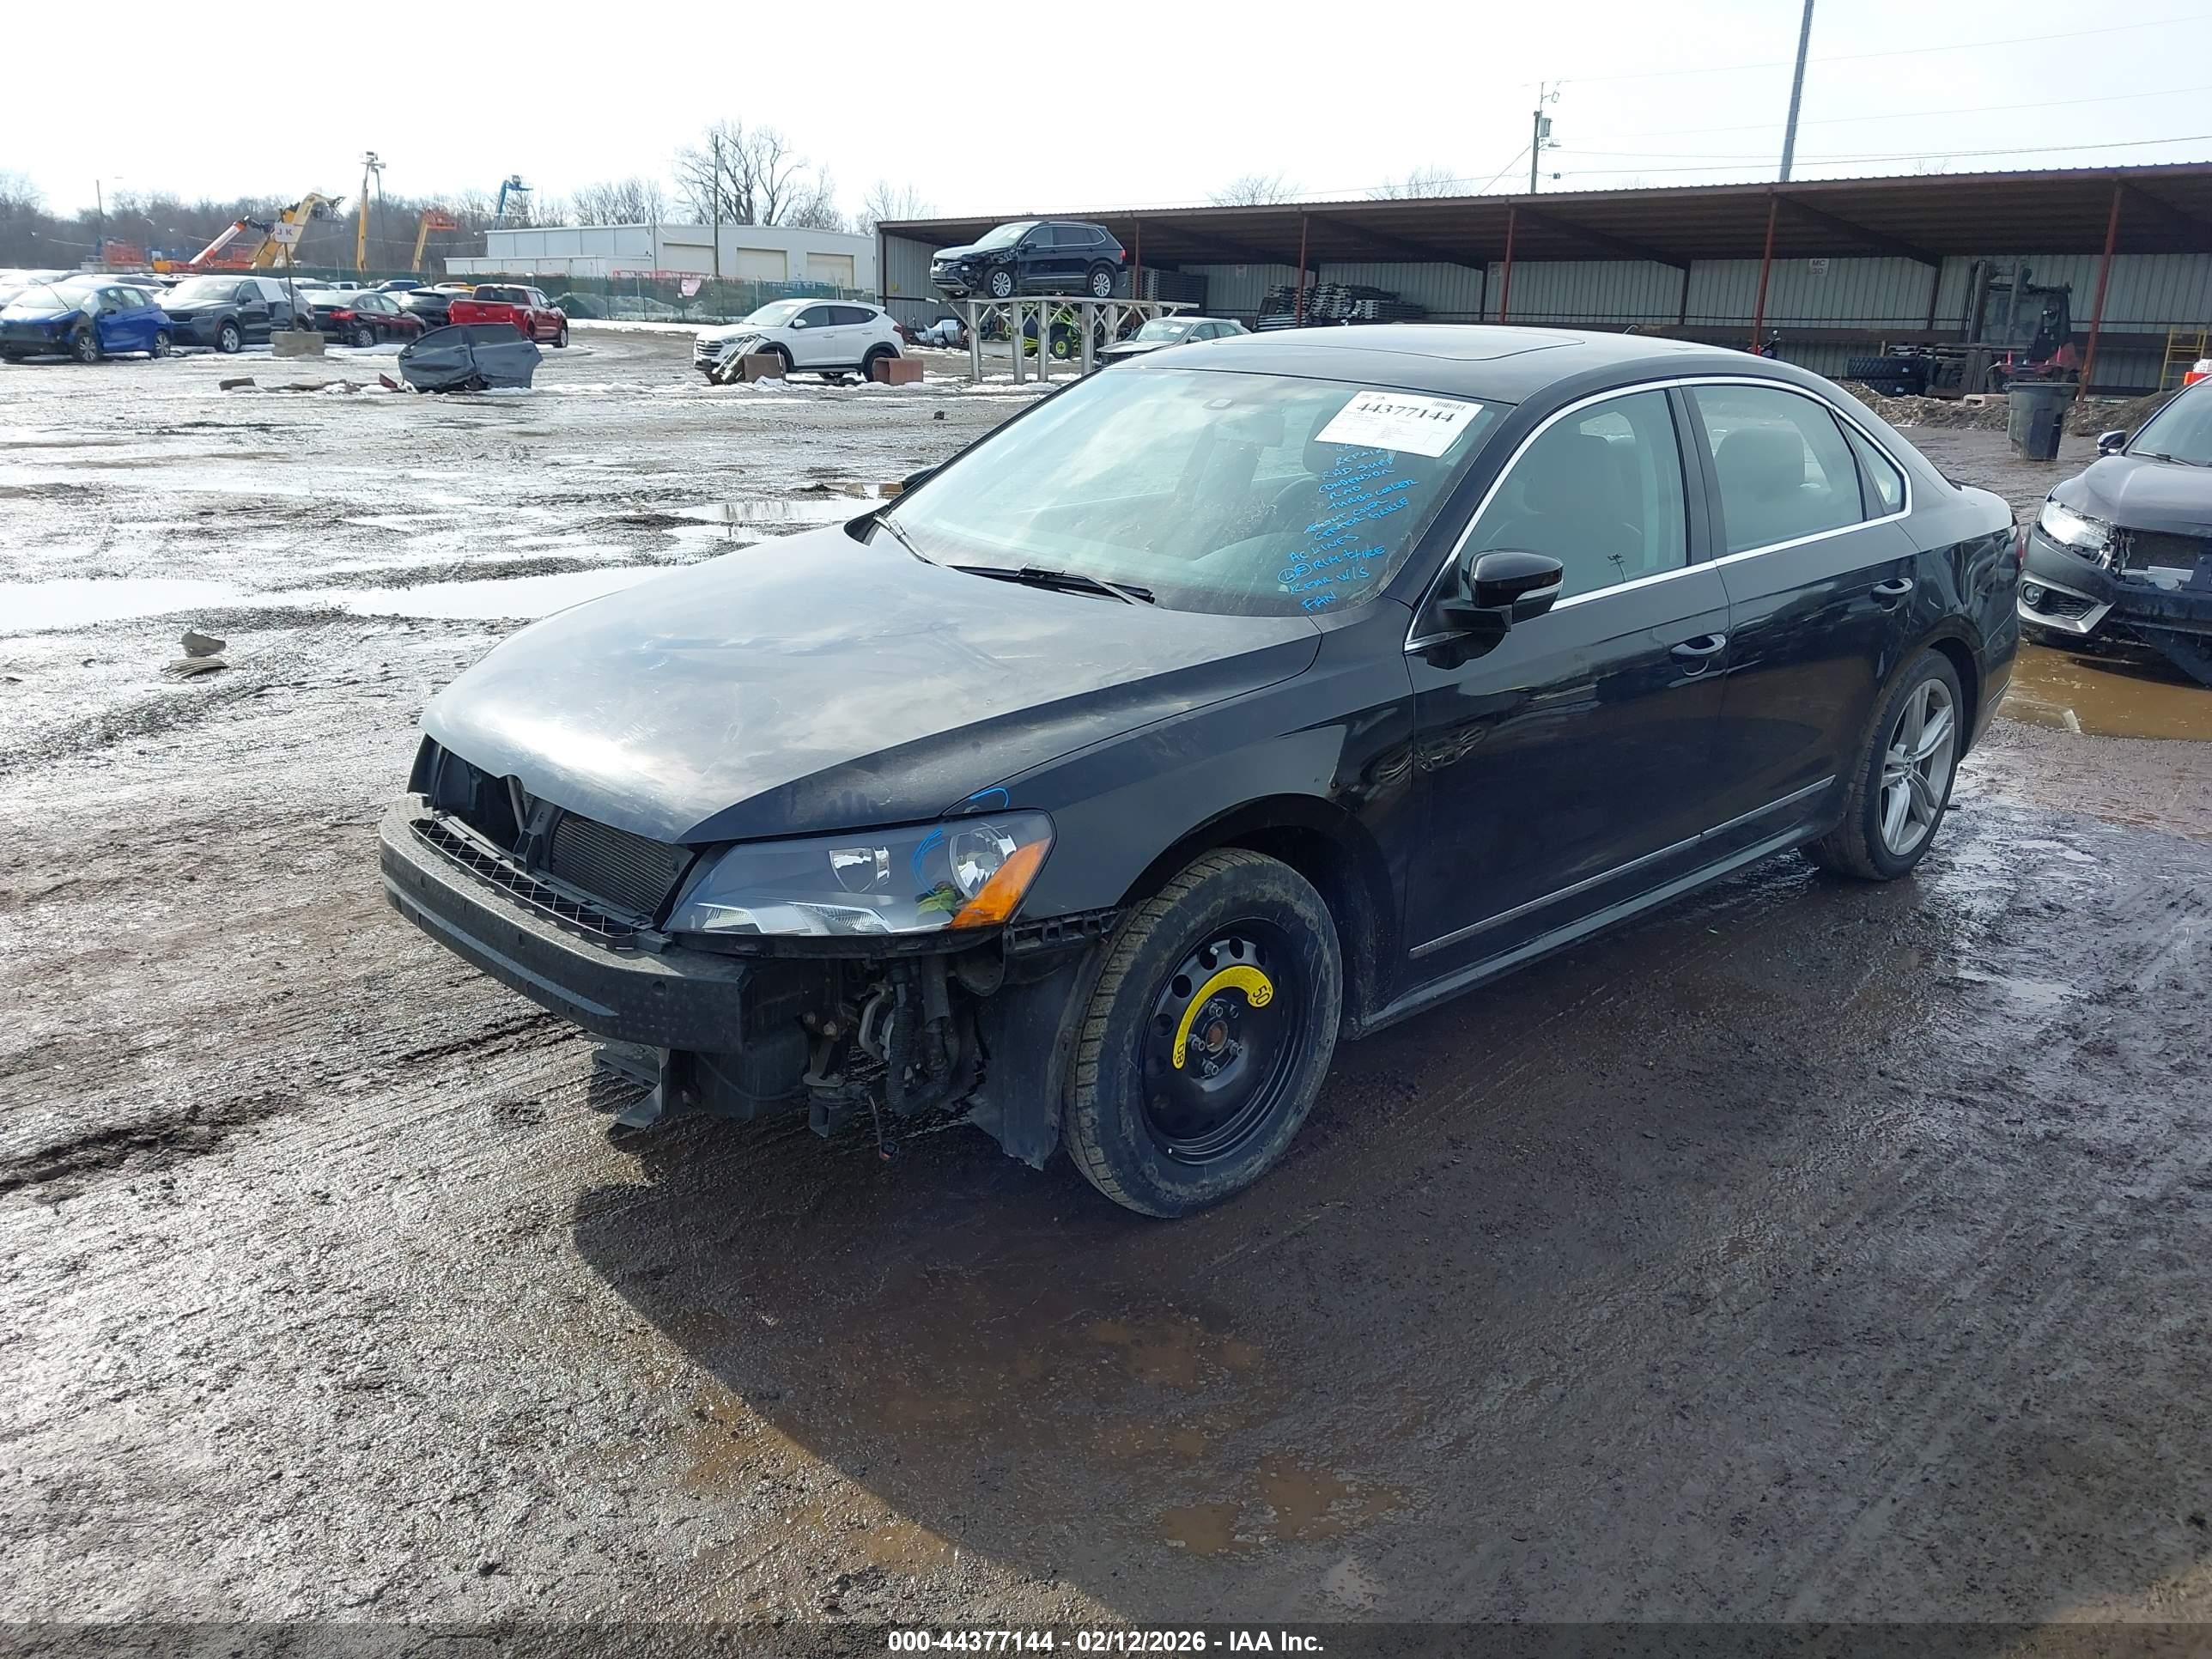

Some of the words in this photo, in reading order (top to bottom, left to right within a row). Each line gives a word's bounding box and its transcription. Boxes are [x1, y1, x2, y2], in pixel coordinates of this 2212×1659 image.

[1357, 403, 1455, 422] 44377144
[1290, 550, 1310, 562] AC
[1313, 555, 1342, 570] RIM
[1301, 590, 1337, 611] FAN
[1253, 985, 1270, 1005] 50
